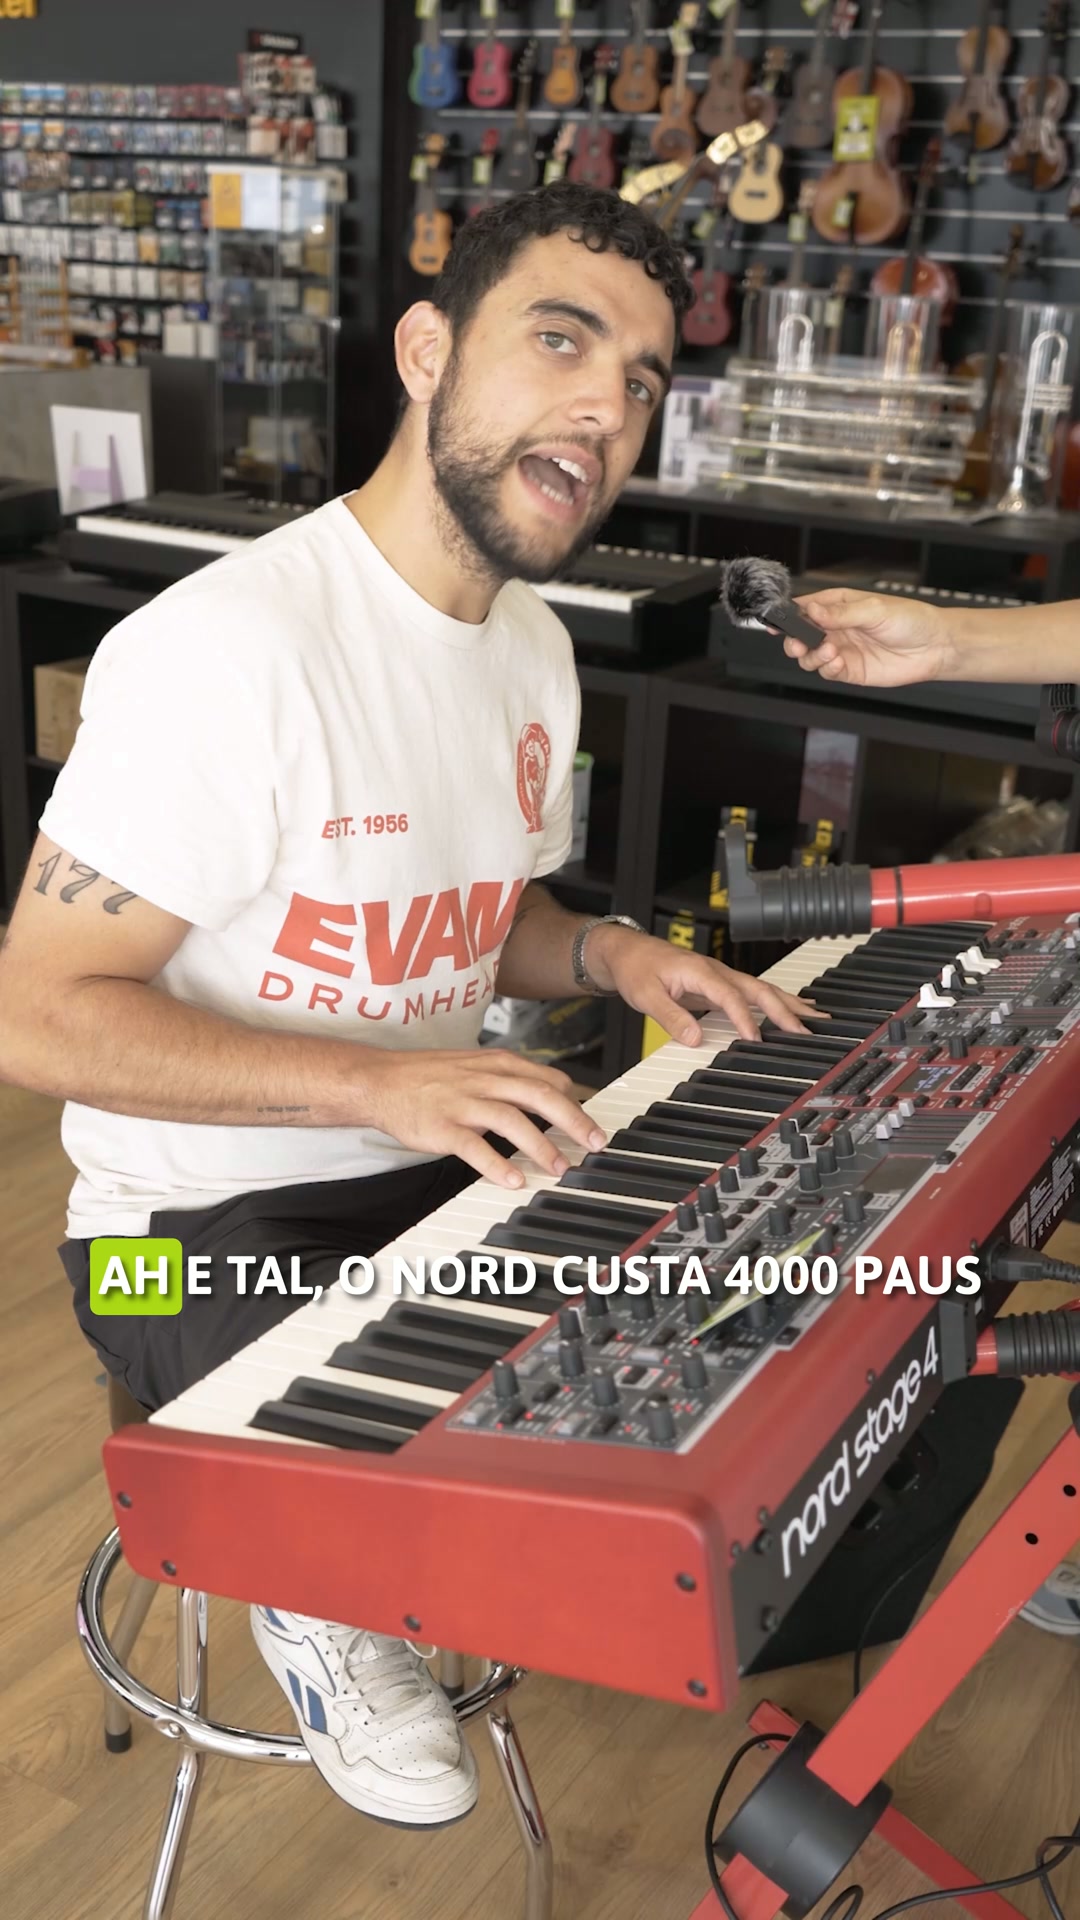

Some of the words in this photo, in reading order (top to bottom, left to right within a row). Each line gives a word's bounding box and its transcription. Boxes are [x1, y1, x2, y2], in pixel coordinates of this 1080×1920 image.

[321, 816, 357, 840] EST.
[363, 813, 409, 836] 1956
[780, 1440, 851, 1578] nord
[853, 1359, 922, 1478] stage
[922, 1325, 940, 1379] 4
